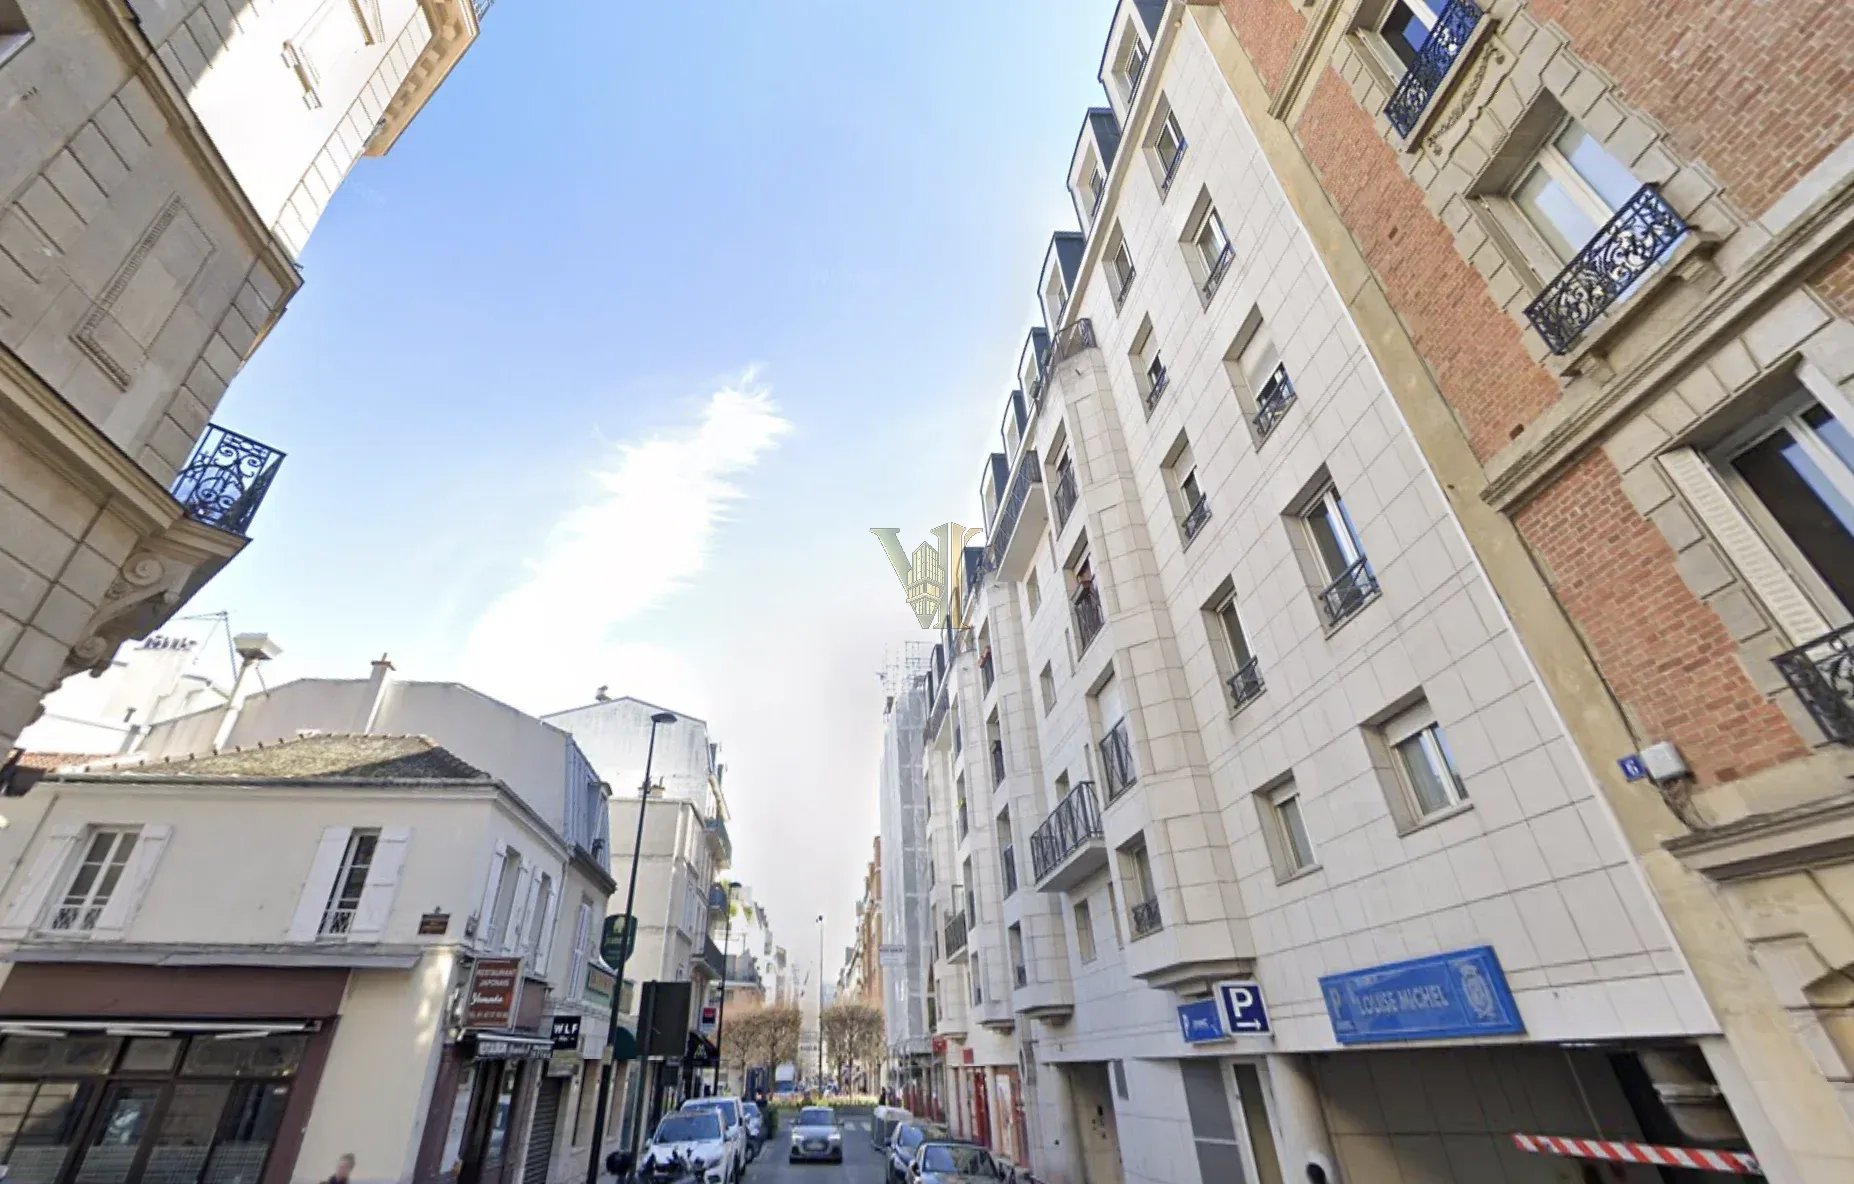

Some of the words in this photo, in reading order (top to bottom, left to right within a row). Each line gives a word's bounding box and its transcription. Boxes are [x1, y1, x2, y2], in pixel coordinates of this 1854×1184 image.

[1229, 988, 1253, 1018] P
[1358, 990, 1399, 1016] LOUISE
[1397, 984, 1450, 1012] MICHEL
